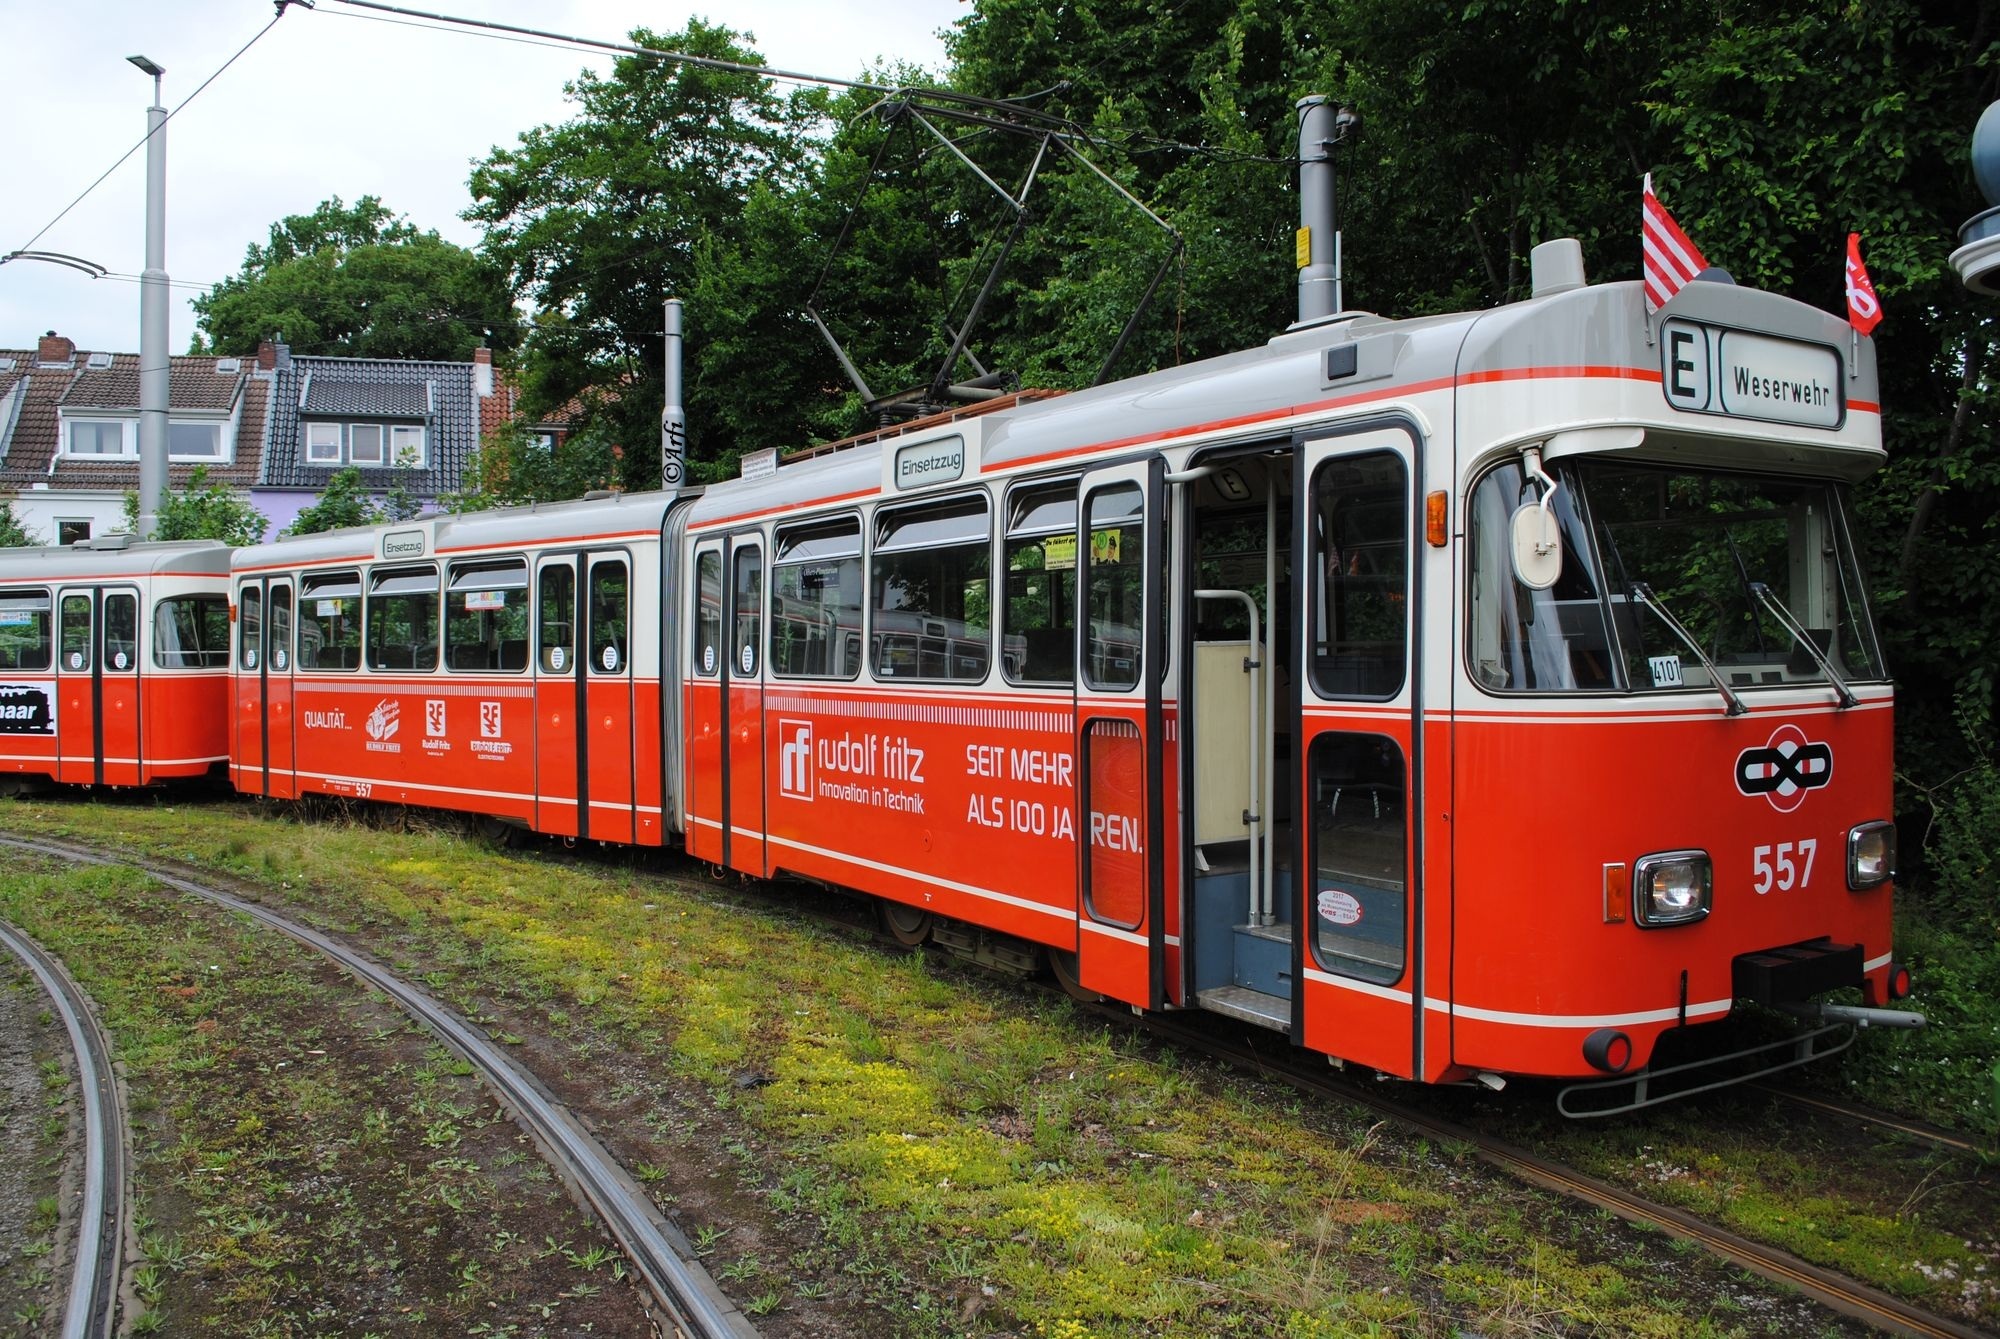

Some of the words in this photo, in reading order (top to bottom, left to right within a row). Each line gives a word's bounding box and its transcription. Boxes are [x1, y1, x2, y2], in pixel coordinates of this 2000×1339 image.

[1671, 331, 1695, 397] E
[1734, 366, 1829, 406] Weserwehr
[902, 453, 961, 475] Einsetzzug
[387, 542, 422, 553] Einsetzzug
[1654, 660, 1681, 682] 4101
[819, 732, 877, 776] rudolf
[884, 735, 924, 783] fritz
[967, 744, 1004, 778] SEIT
[1011, 748, 1072, 787] MEHR
[356, 783, 371, 798] 557
[819, 777, 869, 805] Innovation
[872, 786, 881, 807] in
[883, 788, 924, 814] Technik
[967, 793, 1003, 828] ALS
[1010, 799, 1045, 835] 100
[1754, 838, 1816, 894] 557
